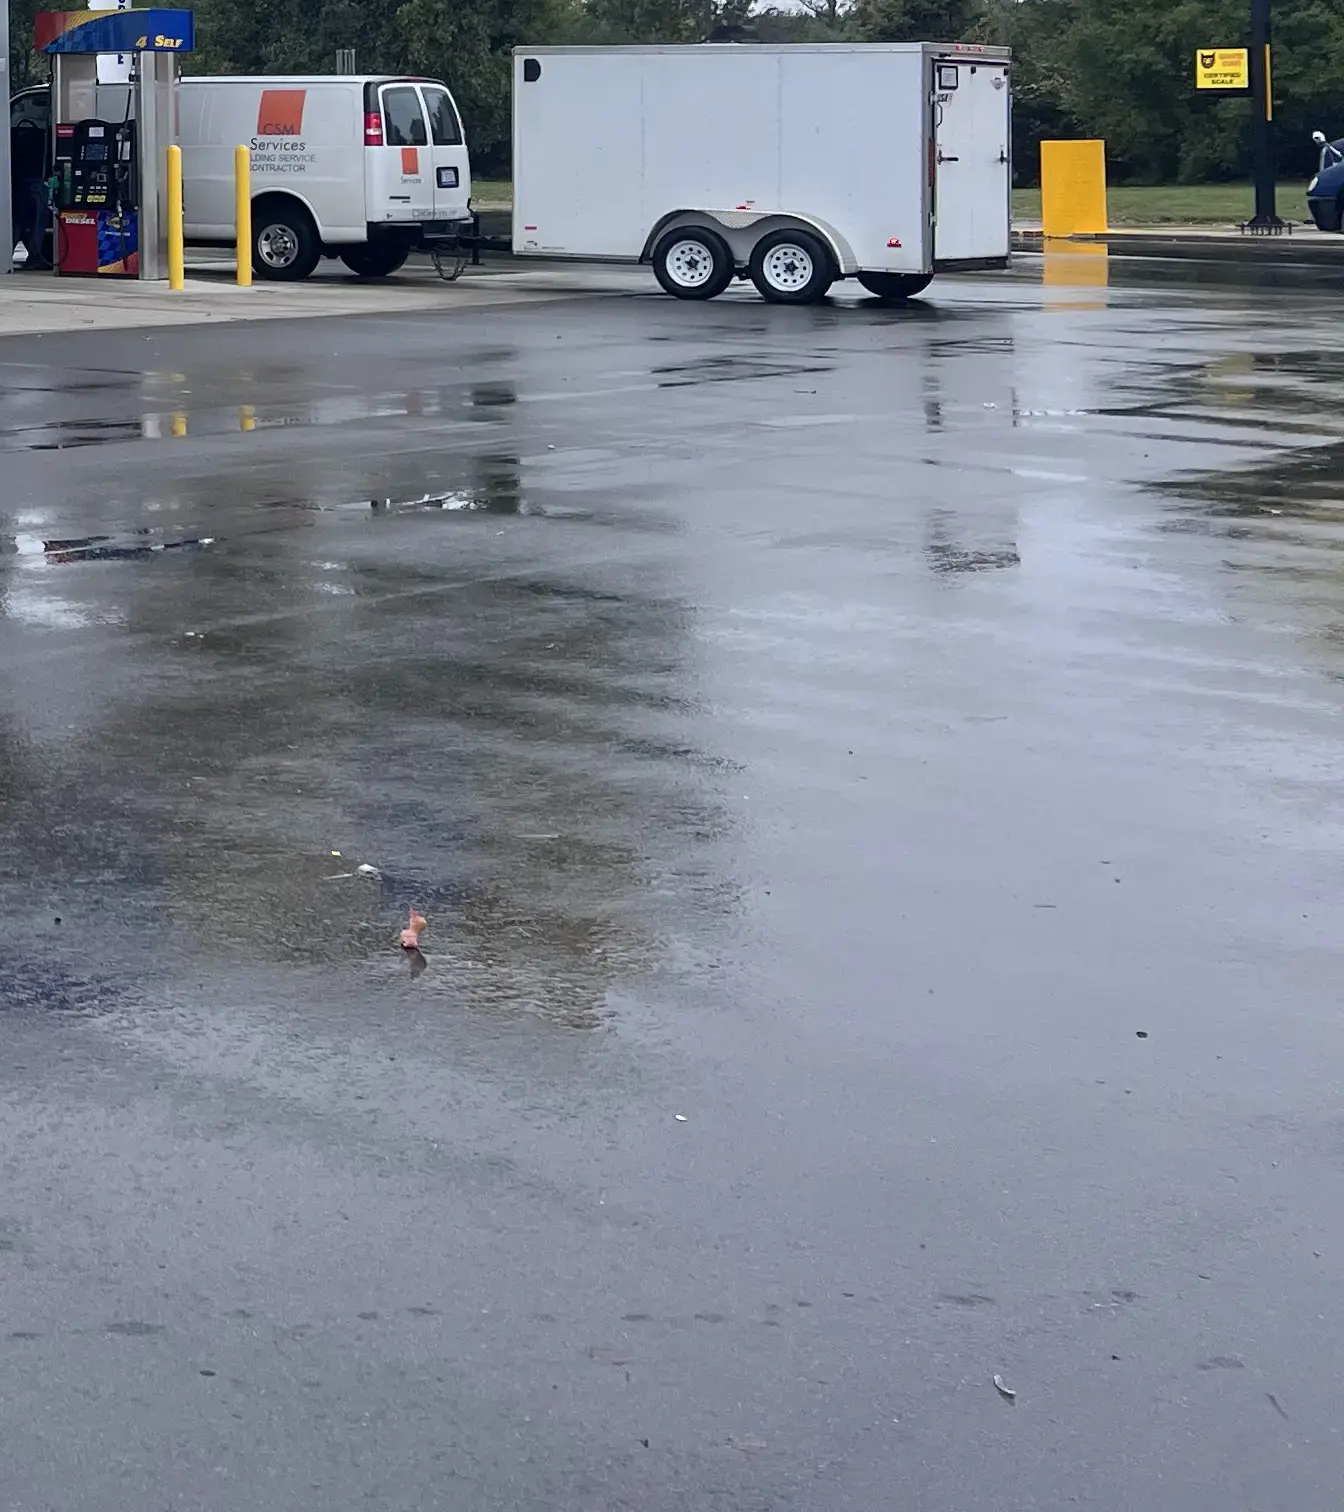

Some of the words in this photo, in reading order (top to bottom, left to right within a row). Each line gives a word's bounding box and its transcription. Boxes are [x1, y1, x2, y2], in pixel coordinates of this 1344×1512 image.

[135, 35, 148, 48] 4
[154, 34, 184, 48] SELF
[262, 123, 295, 136] CSM
[249, 137, 306, 151] Services
[278, 153, 316, 163] SERVICE
[250, 163, 306, 172] ONTRACTOR
